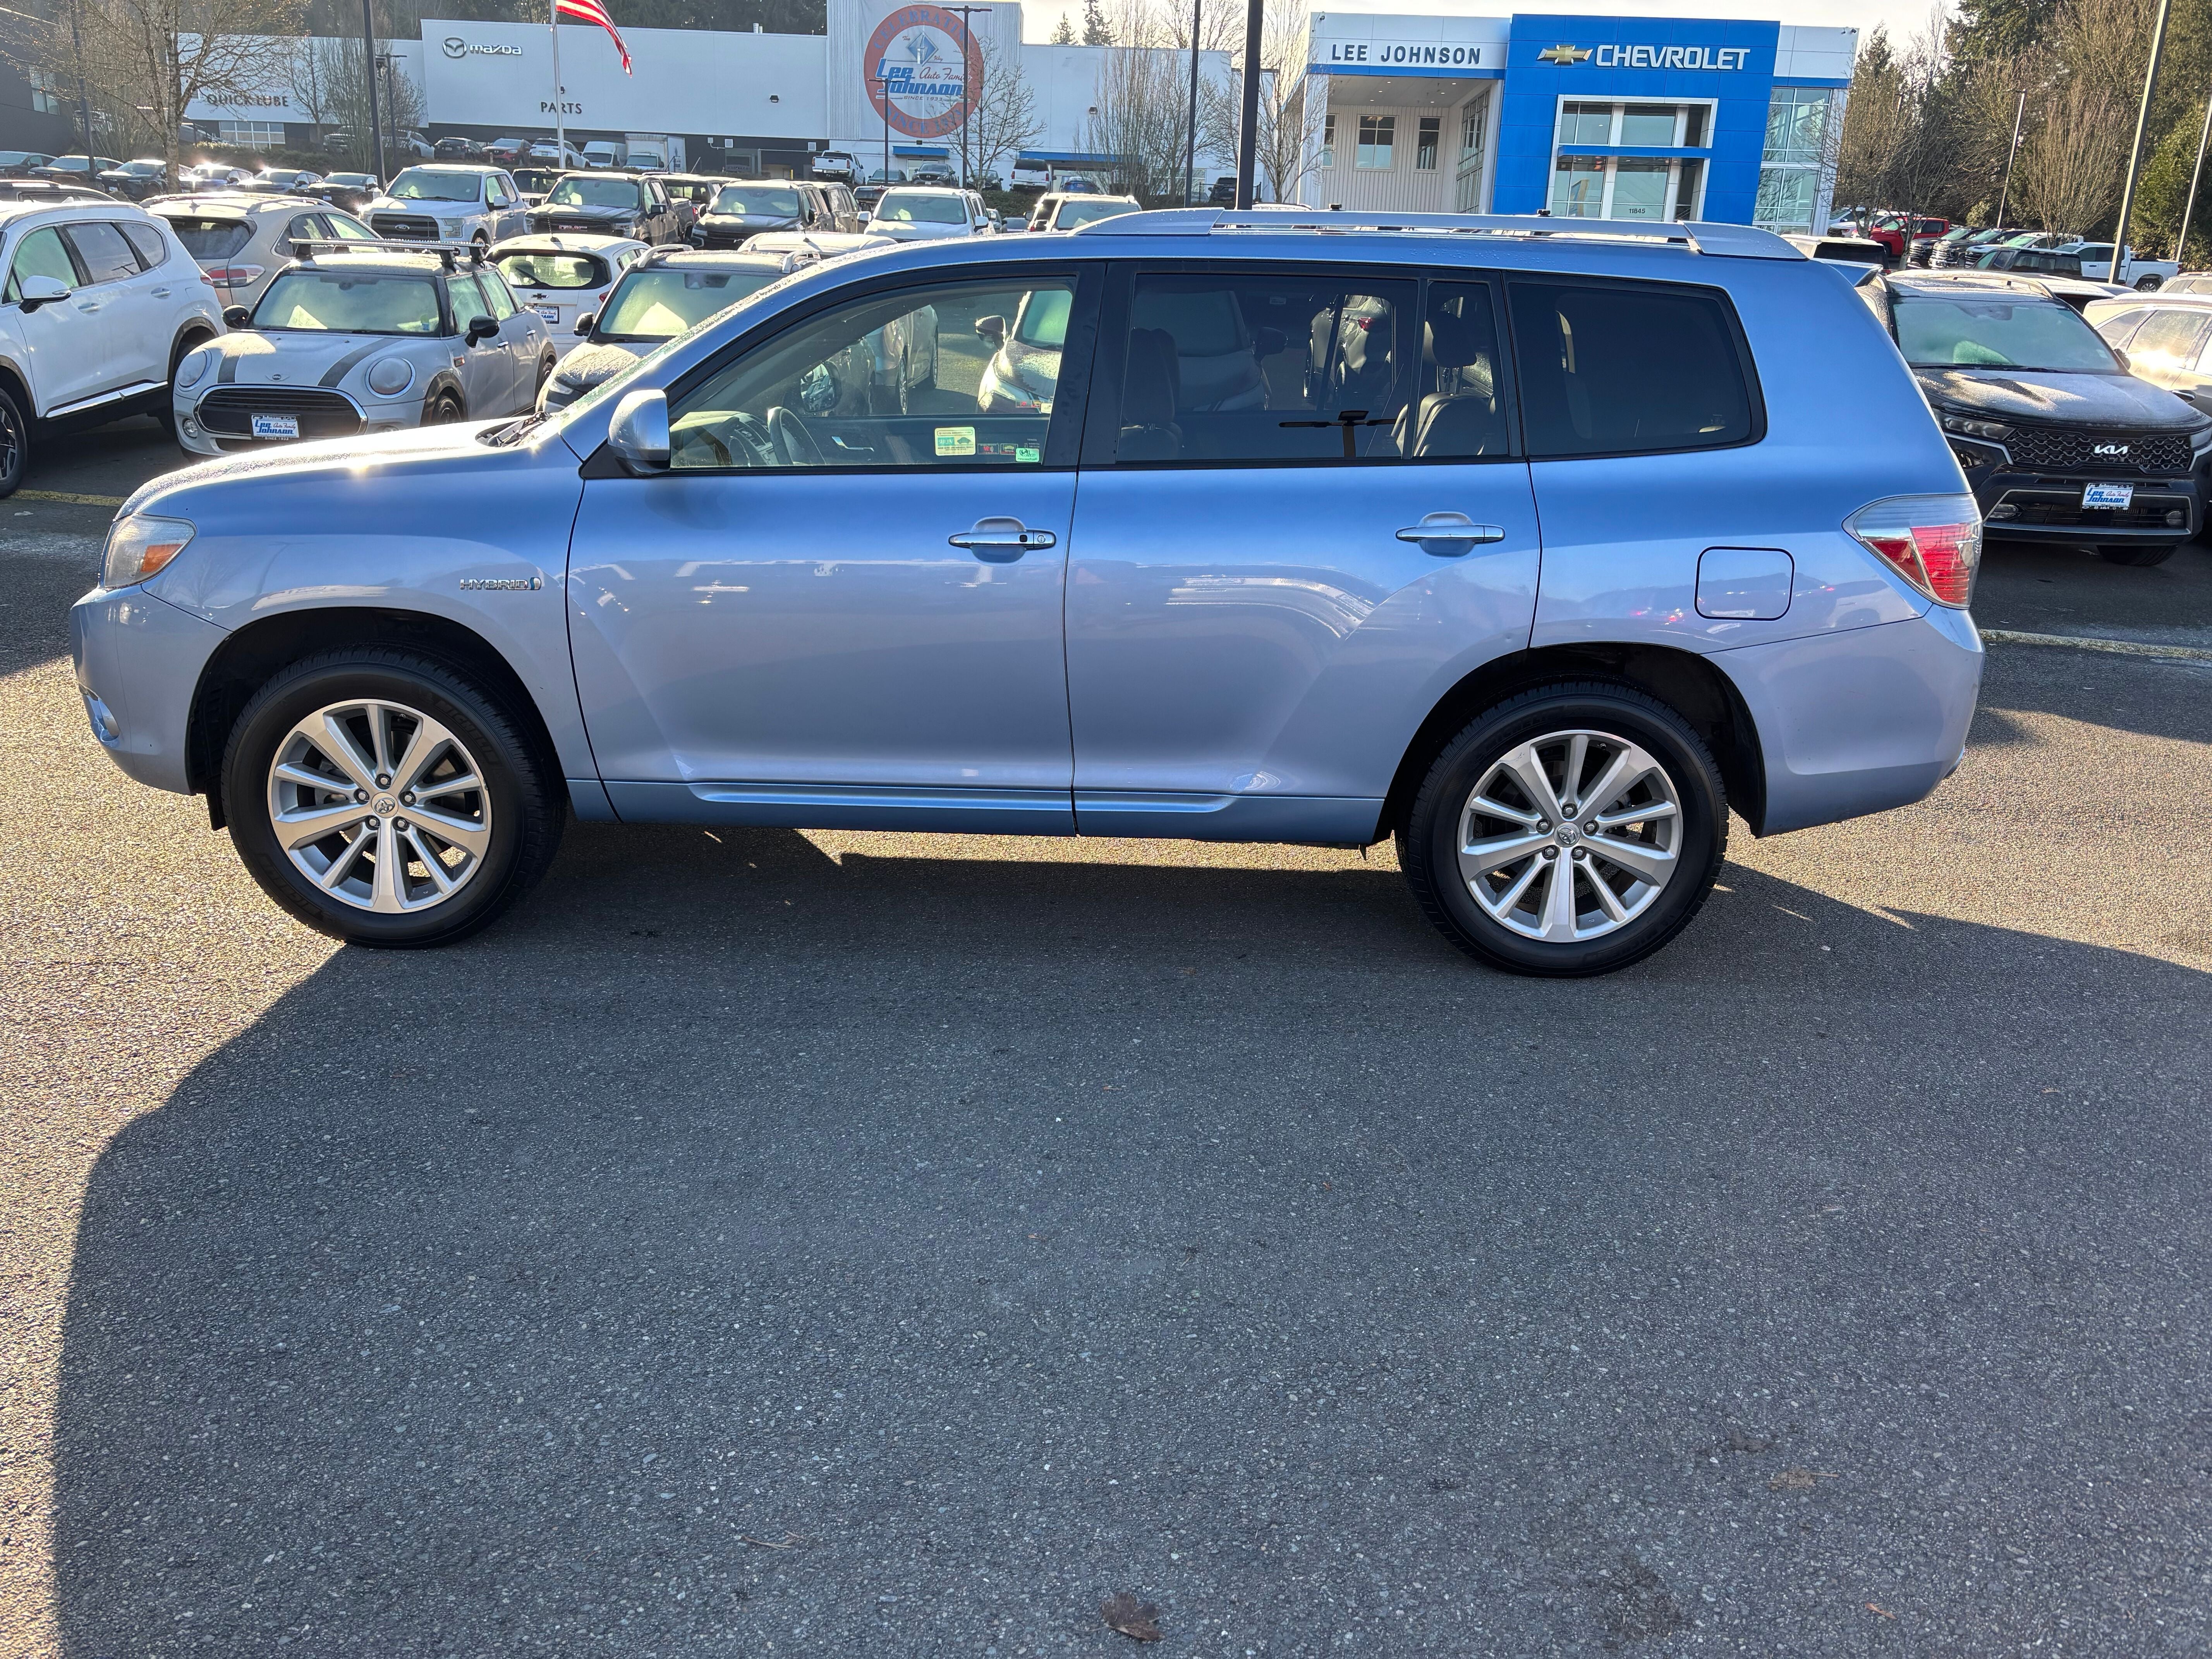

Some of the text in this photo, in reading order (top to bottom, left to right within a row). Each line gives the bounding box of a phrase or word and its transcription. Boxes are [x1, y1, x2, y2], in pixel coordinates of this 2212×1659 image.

[1332, 44, 1480, 64] LEE JOHNSON
[1596, 45, 1750, 70] CHEVROLET
[876, 58, 915, 79] Lee
[919, 67, 941, 79] Auto
[878, 77, 963, 96] Johnson
[207, 94, 289, 106] QUICK LUBE
[541, 101, 582, 114] PARTS
[256, 426, 294, 434] Johnson
[2095, 445, 2128, 455] KIA
[2087, 488, 2104, 496] Lee
[460, 579, 528, 590] HYBRID
